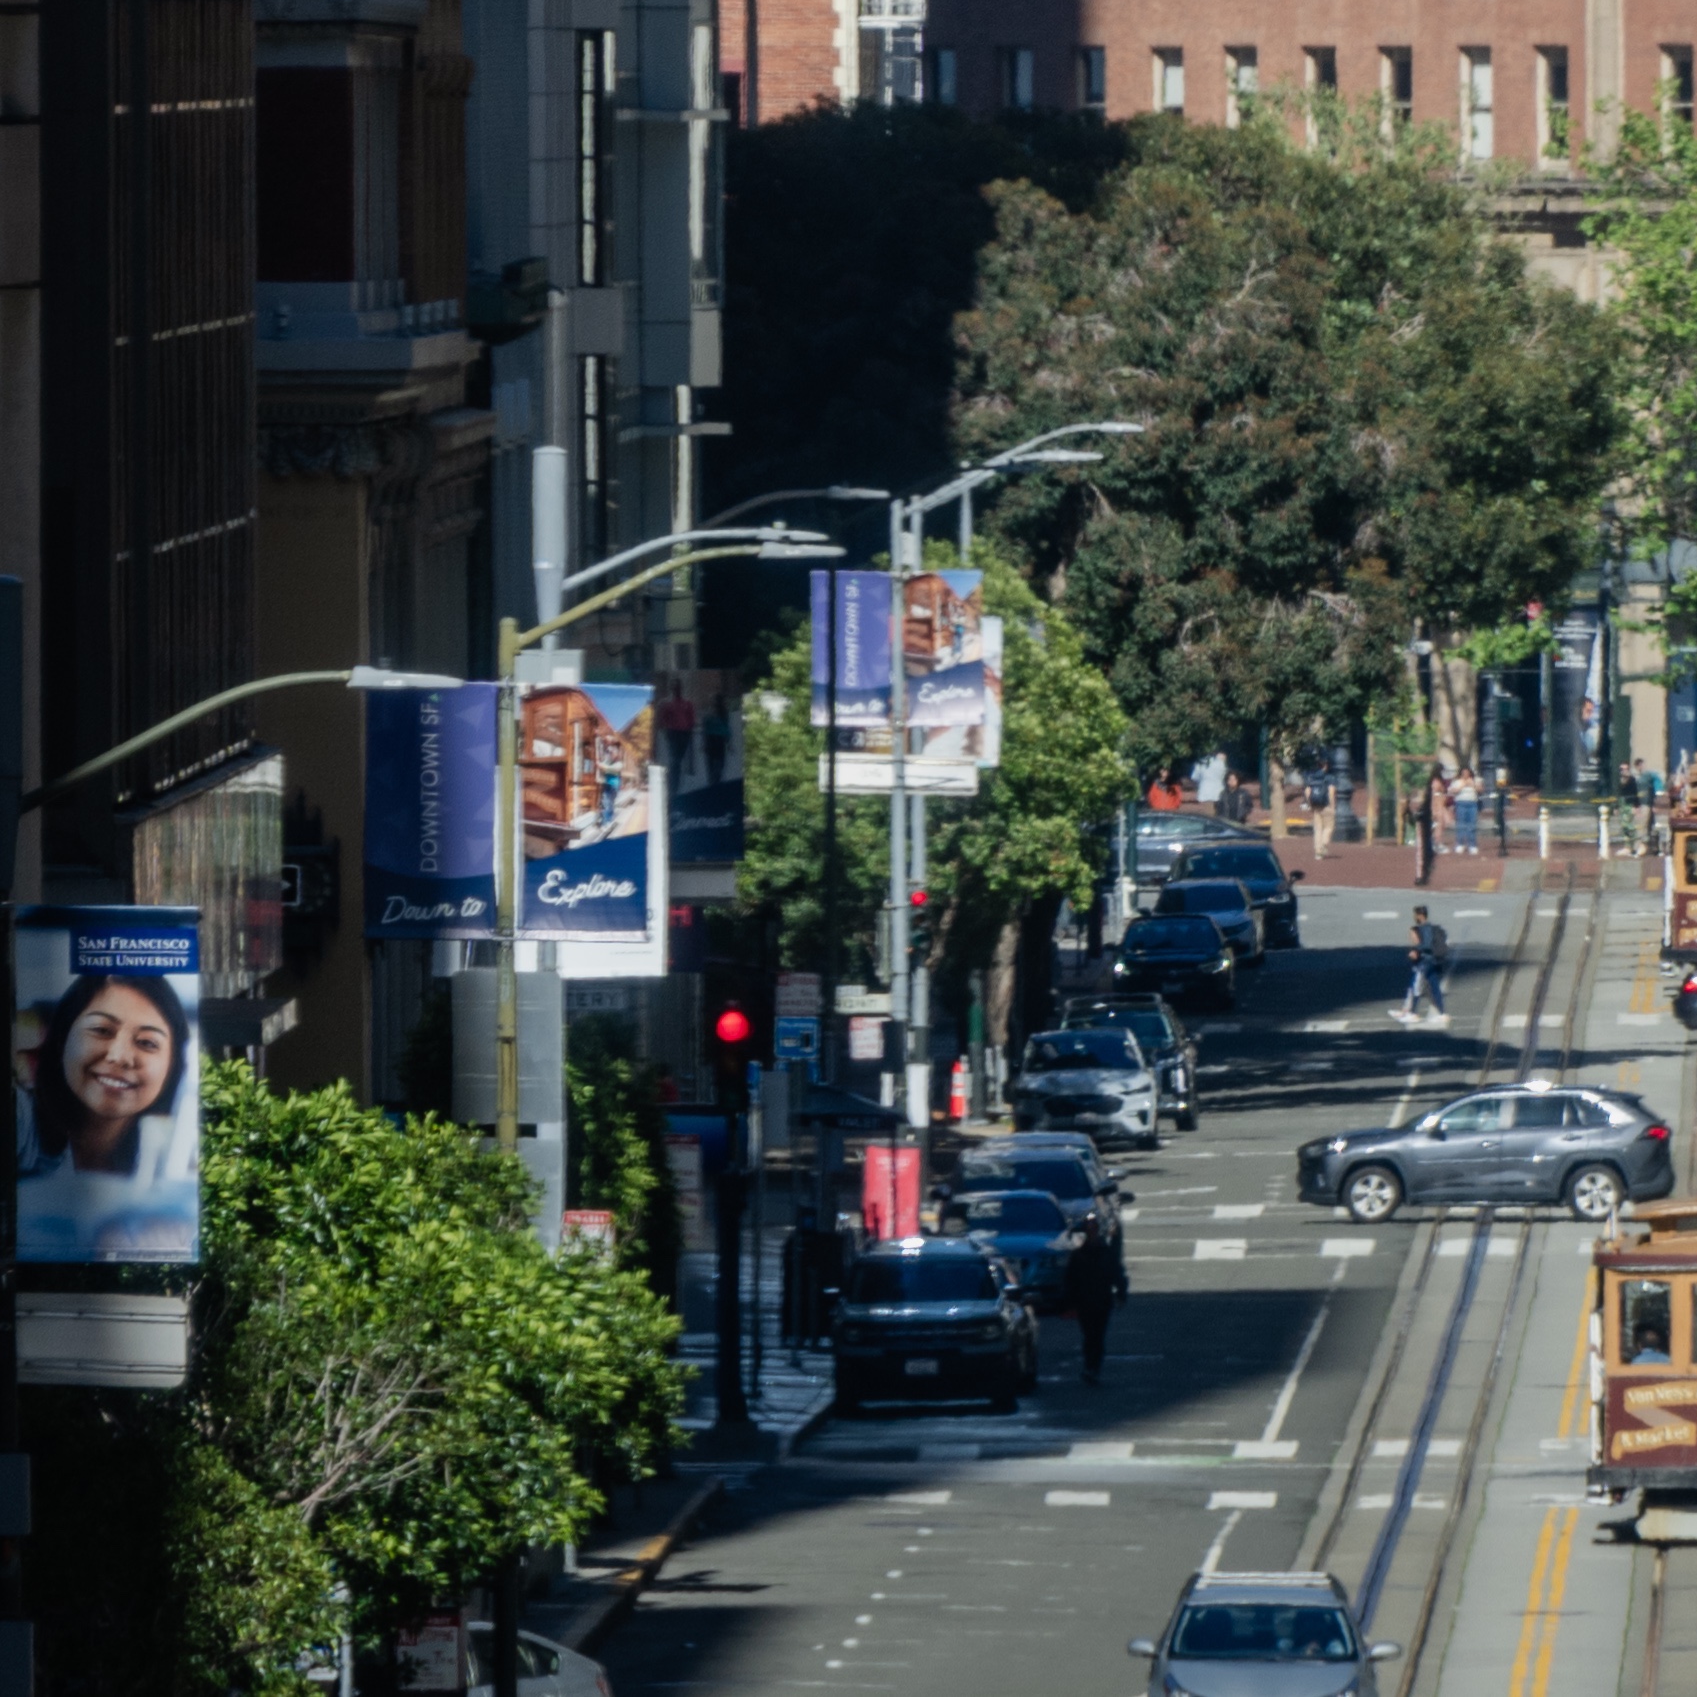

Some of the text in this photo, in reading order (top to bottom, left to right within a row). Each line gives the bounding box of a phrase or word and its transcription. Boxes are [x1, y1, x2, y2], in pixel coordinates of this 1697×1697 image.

[845, 605, 860, 687] DOWNTOWN
[917, 681, 976, 705] Explore
[420, 702, 440, 874] DOWNTOWN SF
[537, 869, 637, 908] Explore
[381, 895, 487, 925] Down to
[78, 936, 190, 950] SAN FRANCISCO
[78, 955, 189, 967] STATE UNIVERSITY
[1627, 1390, 1654, 1404] Van
[1655, 1386, 1693, 1401] Ness
[1635, 1426, 1691, 1444] Market
